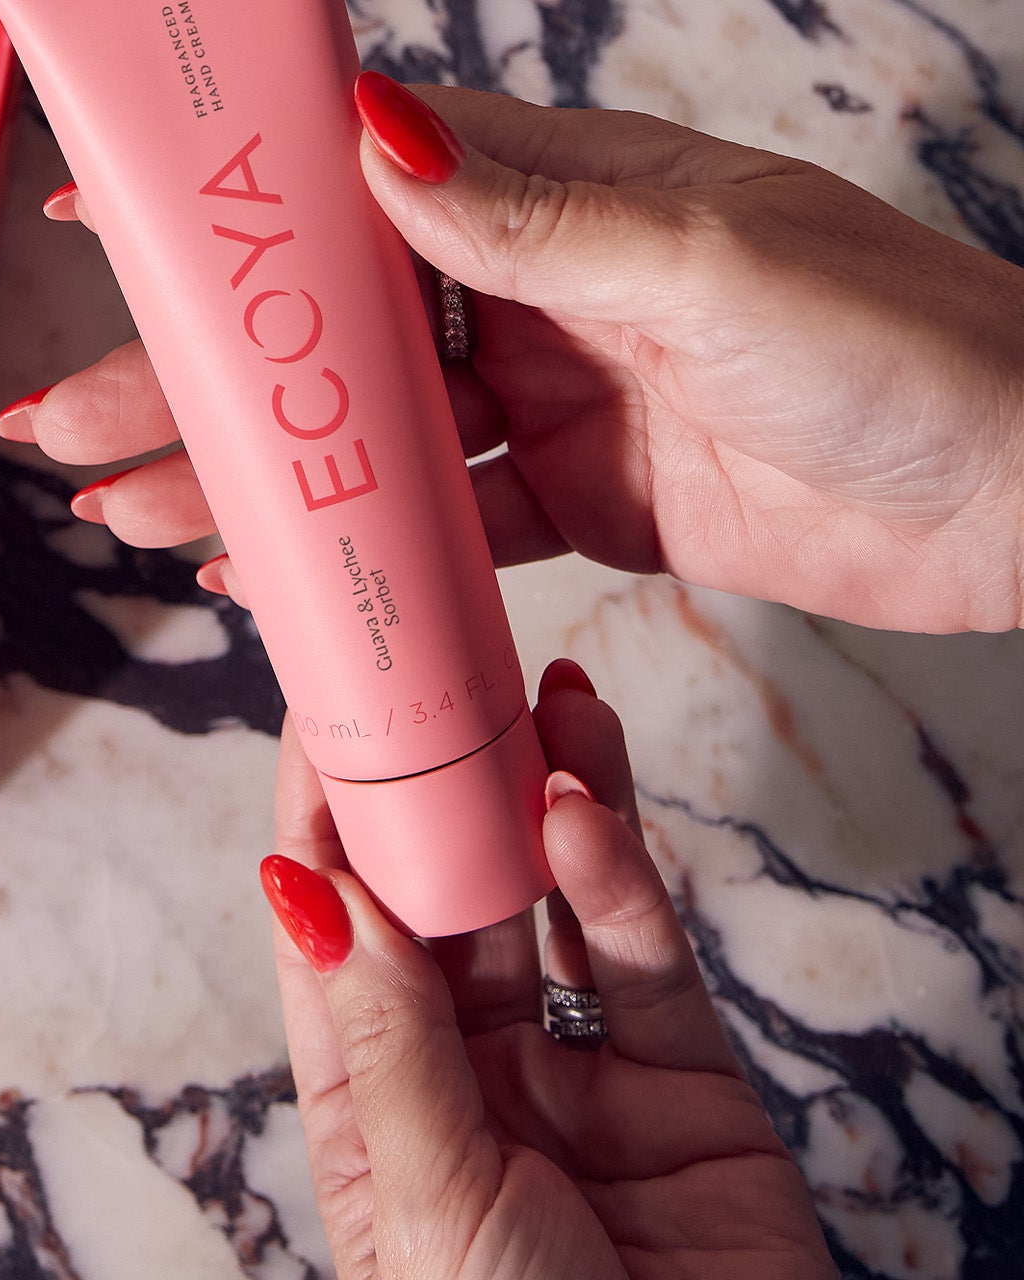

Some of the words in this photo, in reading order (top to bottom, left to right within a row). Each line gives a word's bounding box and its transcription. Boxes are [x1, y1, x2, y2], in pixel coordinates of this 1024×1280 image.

[178, 1, 207, 59] CREAM
[162, 5, 208, 119] FRAGRANCED
[200, 64, 225, 112] HAND
[198, 131, 379, 512] ECOYA
[338, 535, 368, 596] Lychee
[357, 598, 374, 613] &
[369, 568, 401, 627] Sorbet
[366, 616, 394, 672] Guava
[329, 719, 372, 739] mL
[385, 708, 394, 736] /
[409, 691, 455, 724] 3.4
[465, 672, 501, 700] FL.
